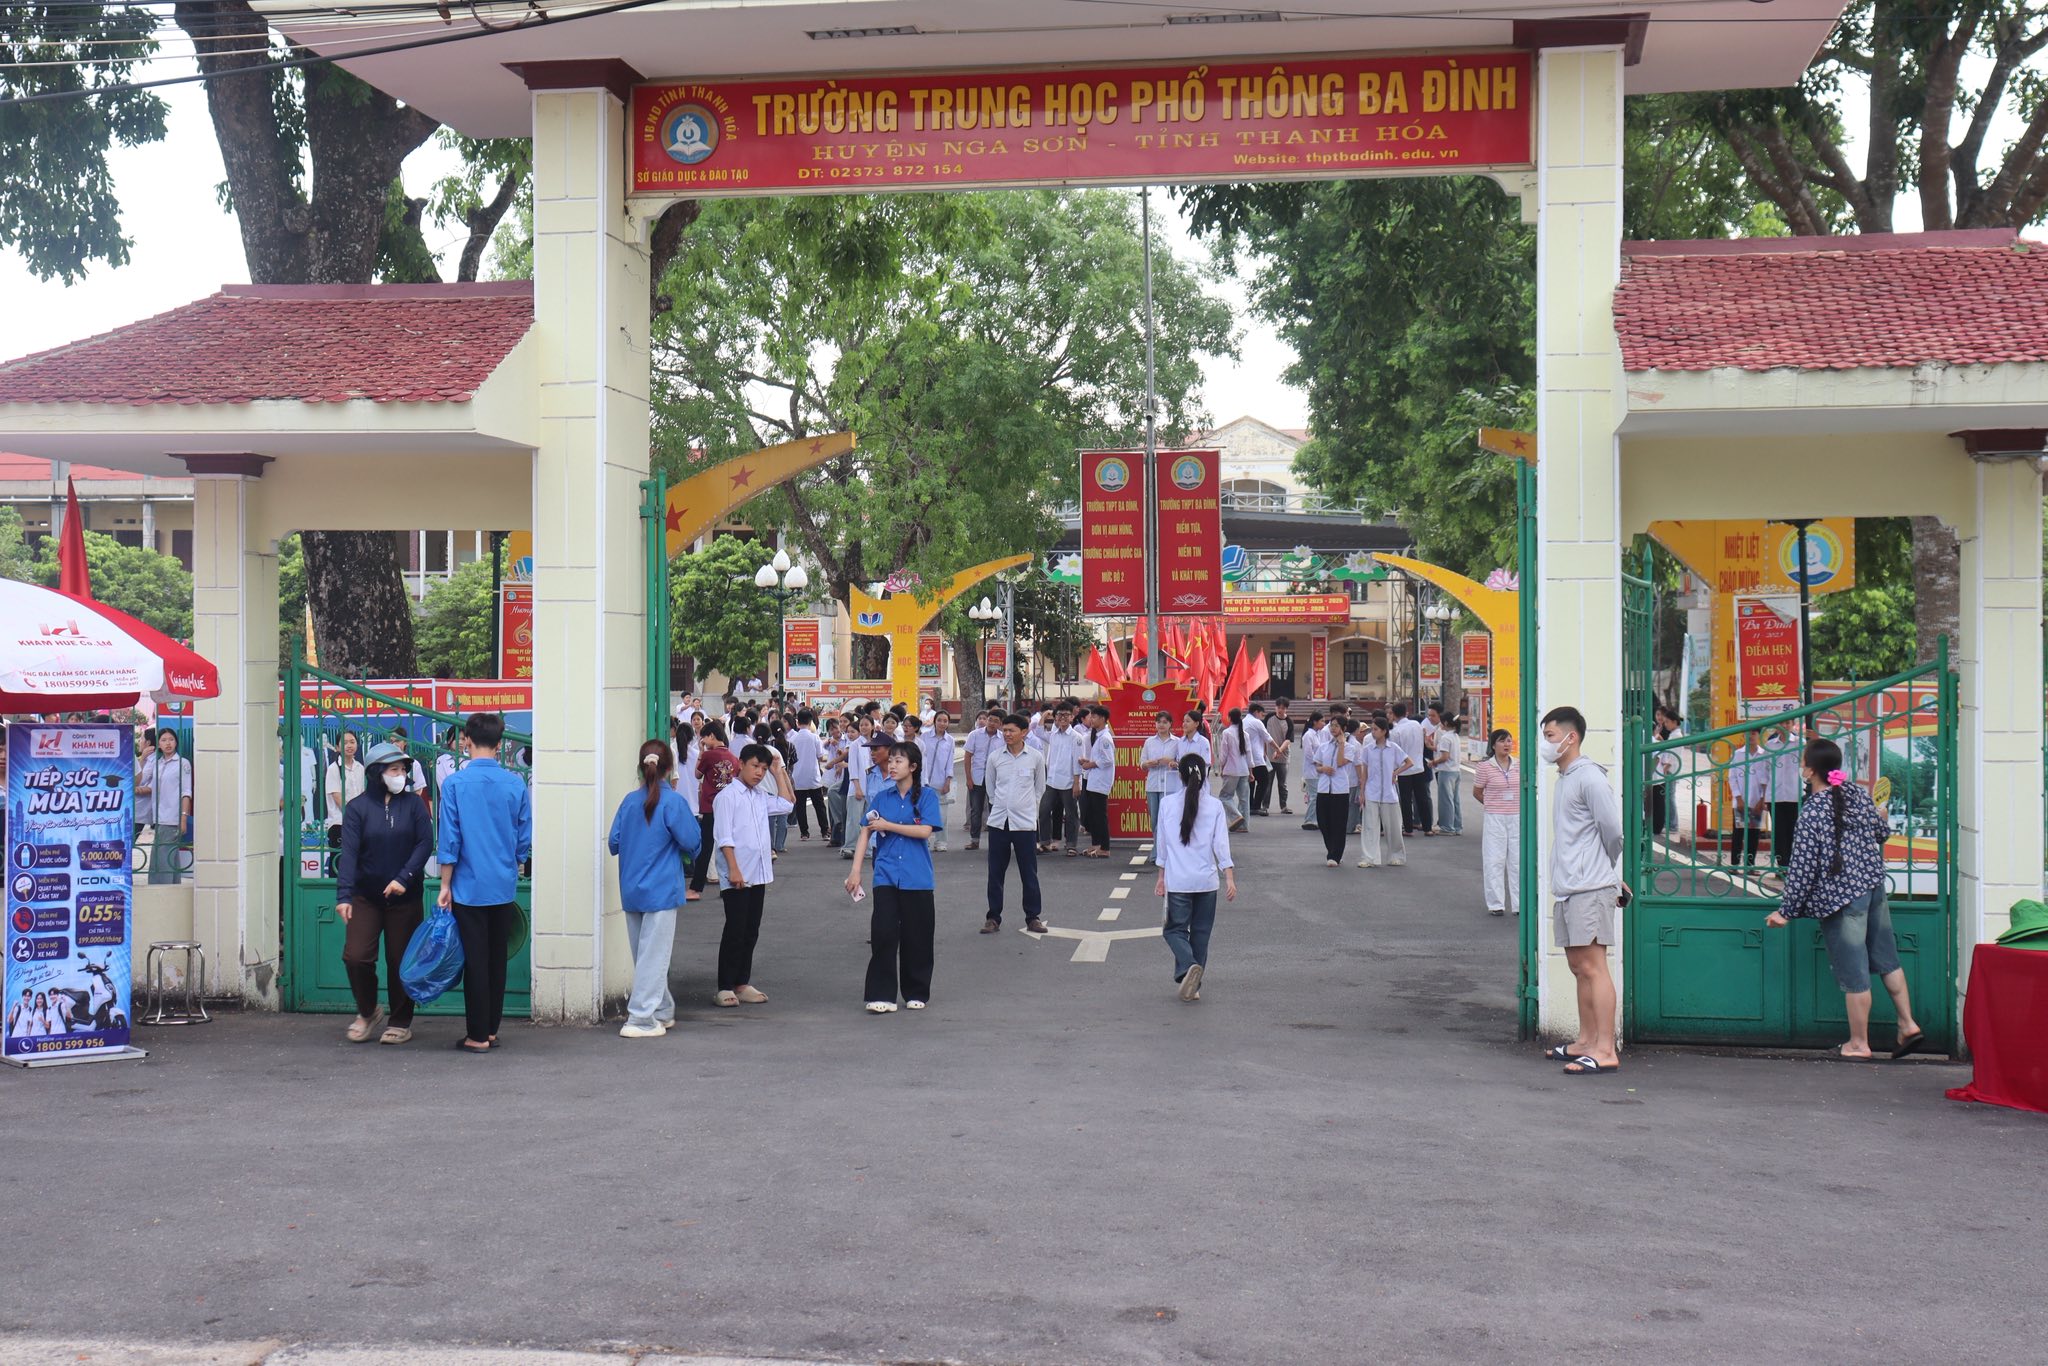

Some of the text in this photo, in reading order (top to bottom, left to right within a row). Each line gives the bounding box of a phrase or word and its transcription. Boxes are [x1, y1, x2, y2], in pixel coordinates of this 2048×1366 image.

[752, 59, 1517, 137] TRƯỜNG TRUNG HỌC PHỔ THÔNG BA ĐÌNH
[644, 105, 662, 142] UBND
[658, 87, 686, 107] TỈNH
[691, 86, 729, 113] THANH
[812, 119, 1448, 162] HUYỆN NGA SƠN TỈNH THANH HÓA
[1233, 152, 1300, 165] Website:
[637, 168, 650, 183] SỞ
[652, 169, 674, 182] GIÁO
[677, 170, 697, 184] DỤC
[700, 170, 707, 181] &
[731, 168, 749, 182] TẠO
[830, 166, 885, 178] 02373
[893, 165, 925, 176] 872
[932, 163, 964, 175] 154
[1106, 501, 1117, 511] THPT
[1118, 501, 1125, 511] BA
[1160, 497, 1181, 510] TRƯỜNG
[1182, 499, 1194, 510] THPT
[1195, 499, 1203, 510] BA
[1724, 531, 1744, 562] NHIỆT
[1121, 572, 1125, 582] 2
[1746, 640, 1792, 658] ĐIỂM HẸN
[1752, 661, 1788, 678] LỊCH SỬ
[44, 679, 109, 689] 1800599956
[24, 765, 98, 788] TIẾP SỨC
[28, 788, 121, 812] MÙA THI
[1121, 806, 1137, 832] CẤM
[77, 876, 110, 885] ICON
[36, 1041, 62, 1051] 1800
[65, 1039, 84, 1049] 599
[86, 1038, 104, 1048] 956
